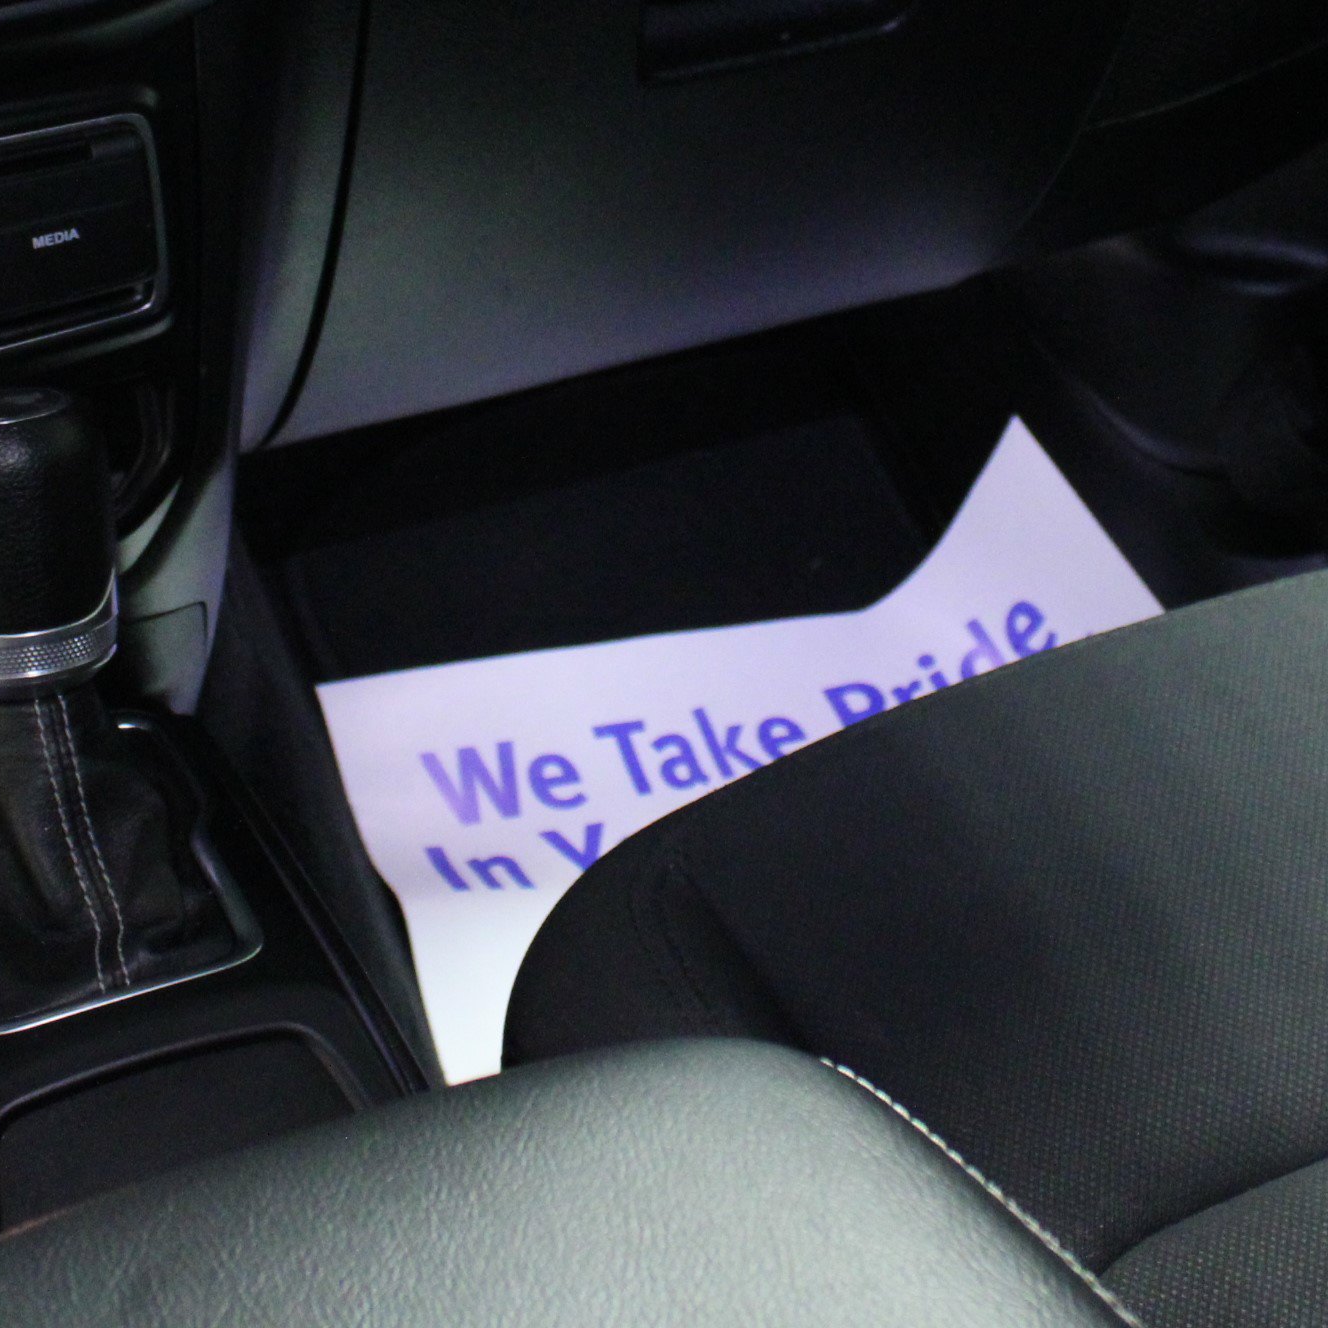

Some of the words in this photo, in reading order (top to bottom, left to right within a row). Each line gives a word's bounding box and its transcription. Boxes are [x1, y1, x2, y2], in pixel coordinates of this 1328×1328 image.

[32, 228, 80, 249] MEDIA
[420, 742, 587, 824] We
[592, 707, 806, 795] Take
[425, 846, 535, 891] In
